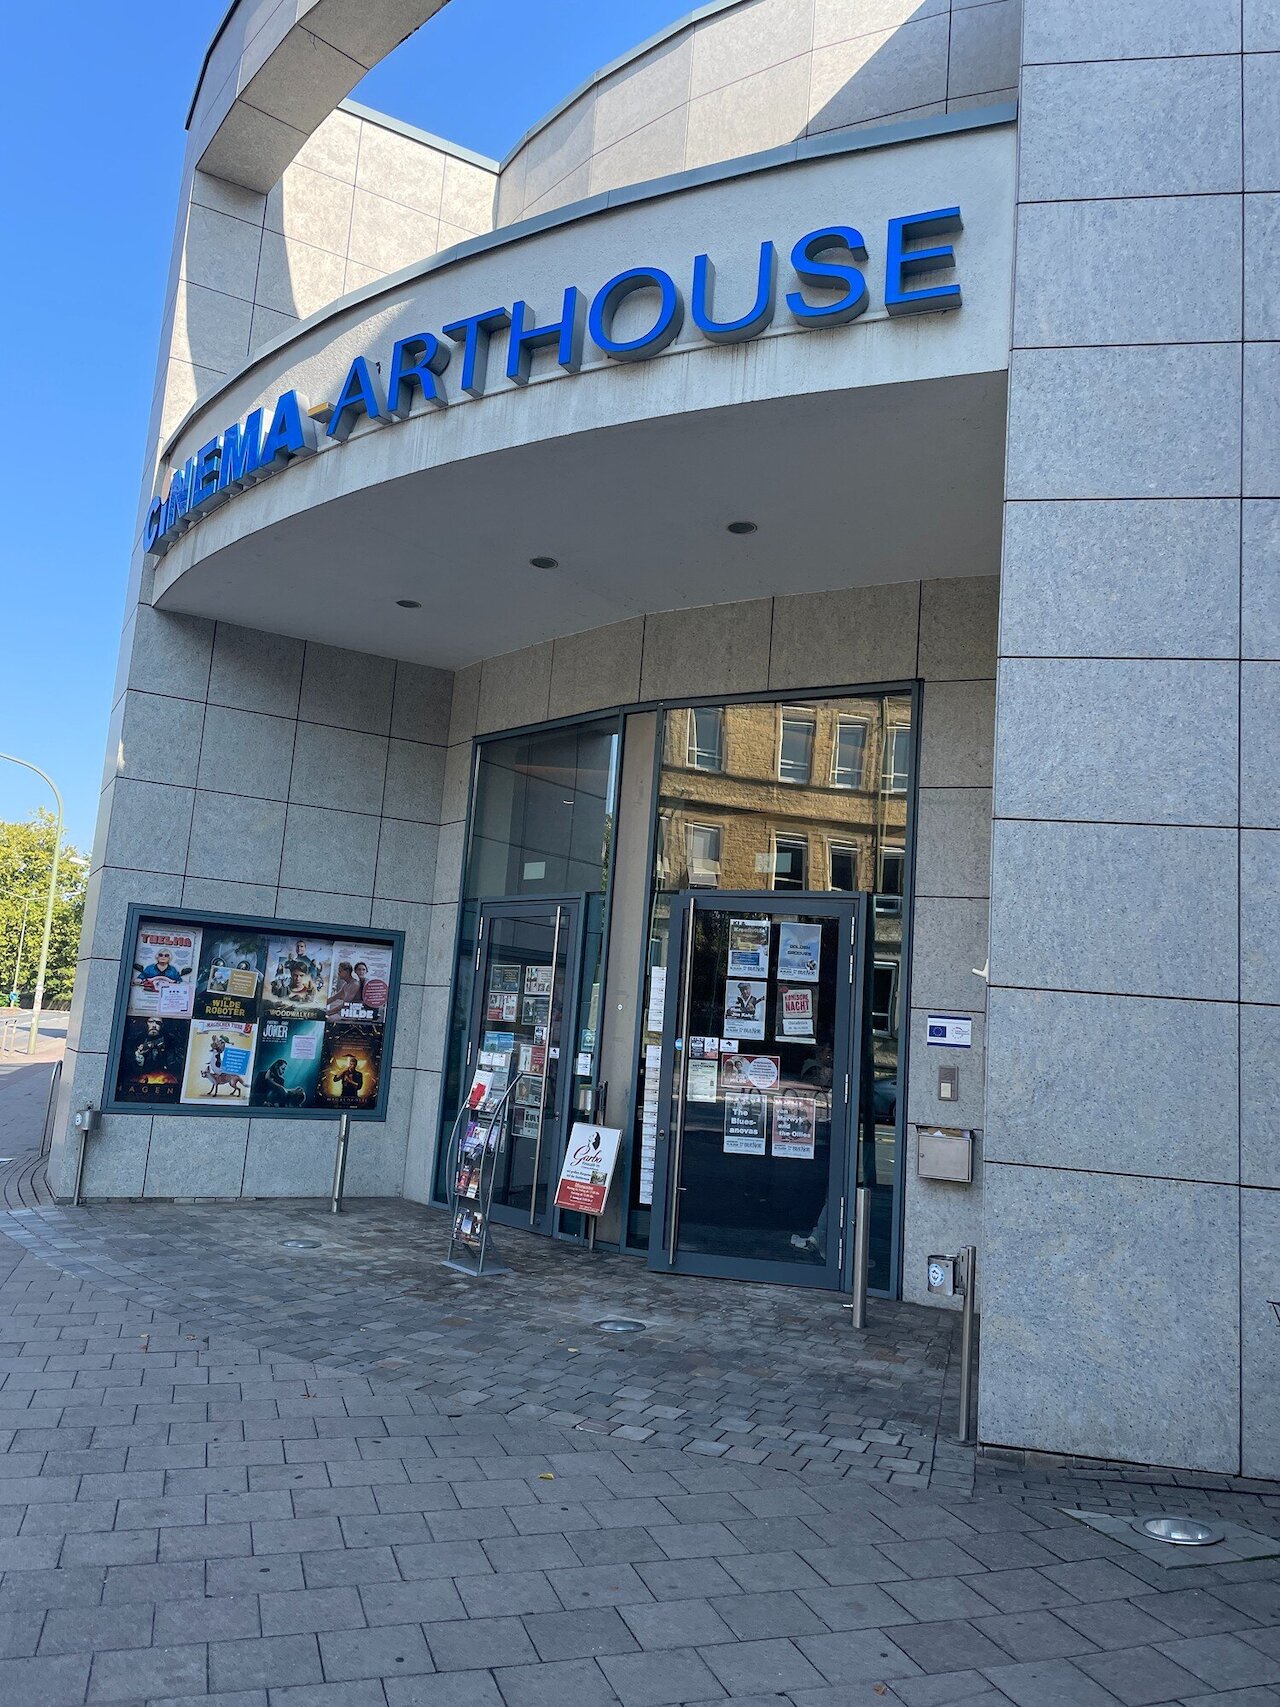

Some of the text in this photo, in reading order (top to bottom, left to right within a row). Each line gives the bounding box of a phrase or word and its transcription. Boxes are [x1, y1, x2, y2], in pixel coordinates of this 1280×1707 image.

[141, 933, 192, 948] THELMA
[212, 1000, 241, 1010] WILDE
[785, 1000, 810, 1011] NACHT
[205, 1006, 246, 1017] ROBOTER
[341, 1008, 373, 1019] HILDE
[263, 1024, 288, 1038] JOKER
[732, 1108, 749, 1117] The
[731, 1117, 757, 1127] Blues-
[729, 1127, 759, 1136] anovas
[570, 1145, 603, 1167] Garbo
